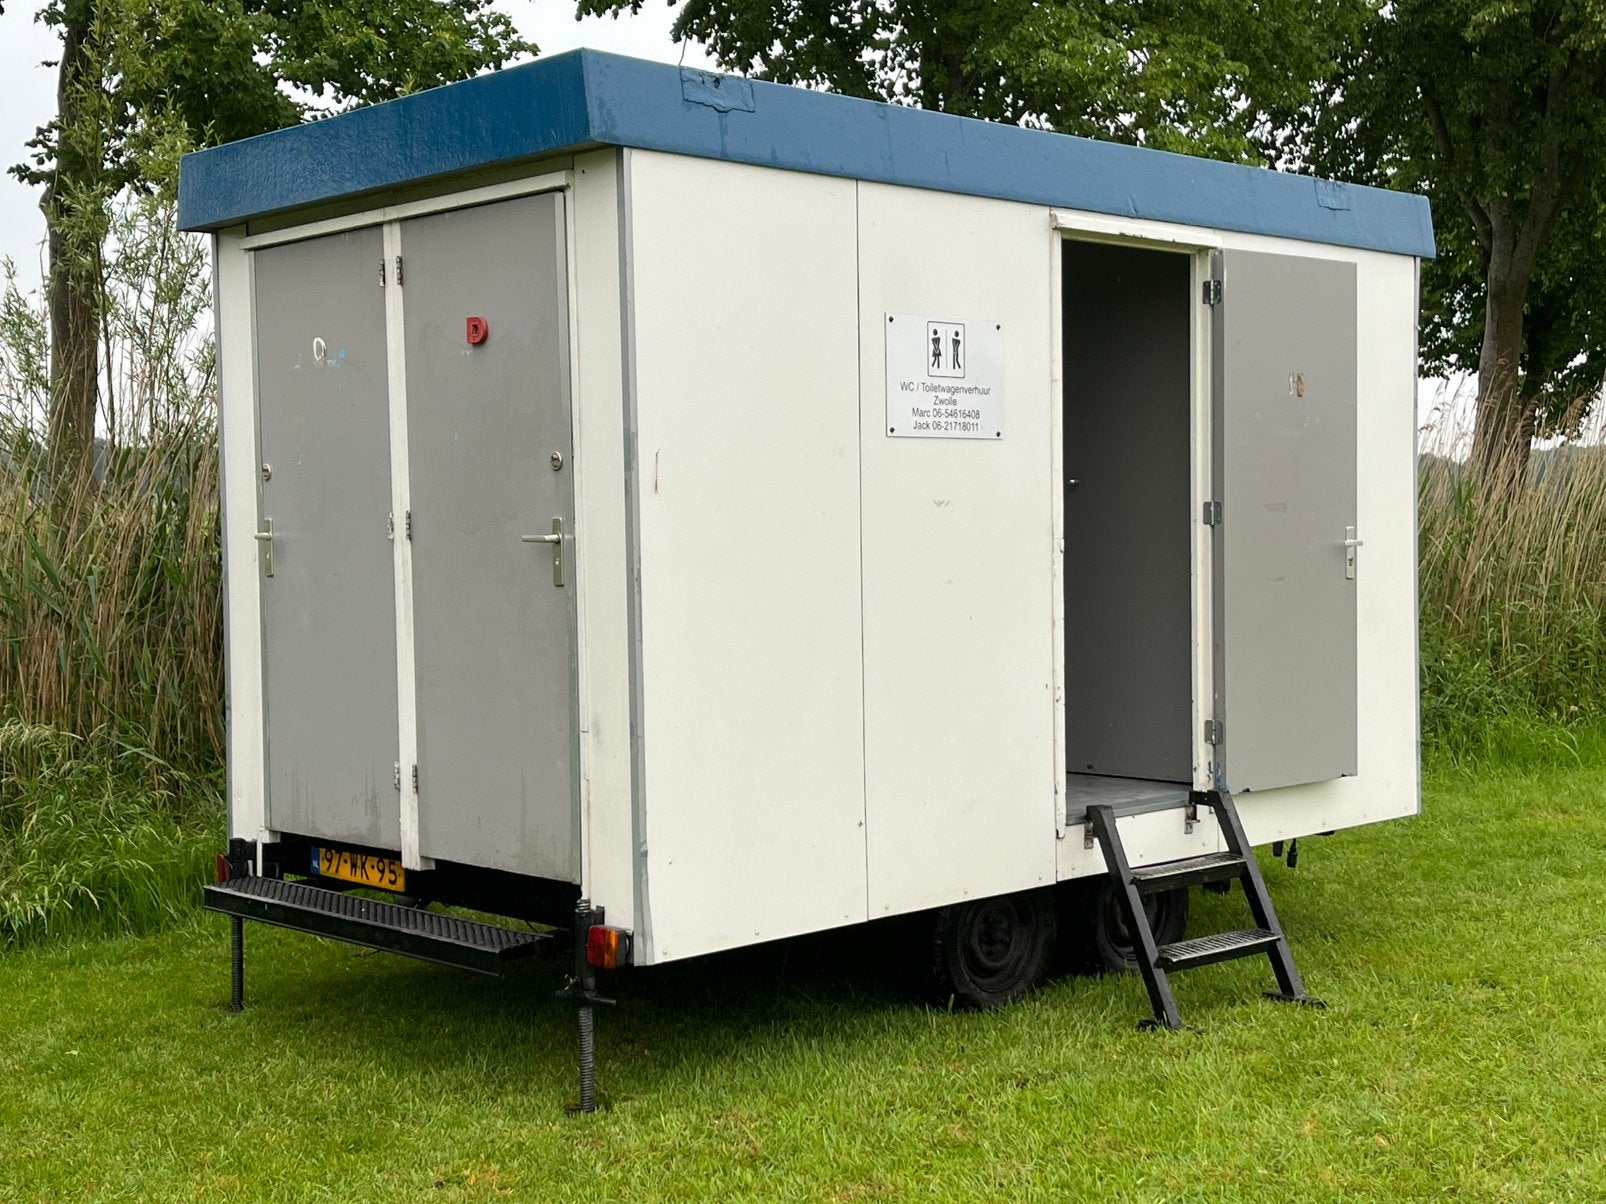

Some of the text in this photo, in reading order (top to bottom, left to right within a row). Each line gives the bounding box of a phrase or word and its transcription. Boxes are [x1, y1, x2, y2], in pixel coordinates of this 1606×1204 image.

[466, 316, 489, 345] D
[900, 381, 914, 392] WC
[921, 382, 991, 396] Toiletwagenverhuur
[933, 396, 957, 406] Zwolle
[912, 407, 980, 420] Marc 06-54616408
[913, 420, 979, 432] Jack 06-21718011
